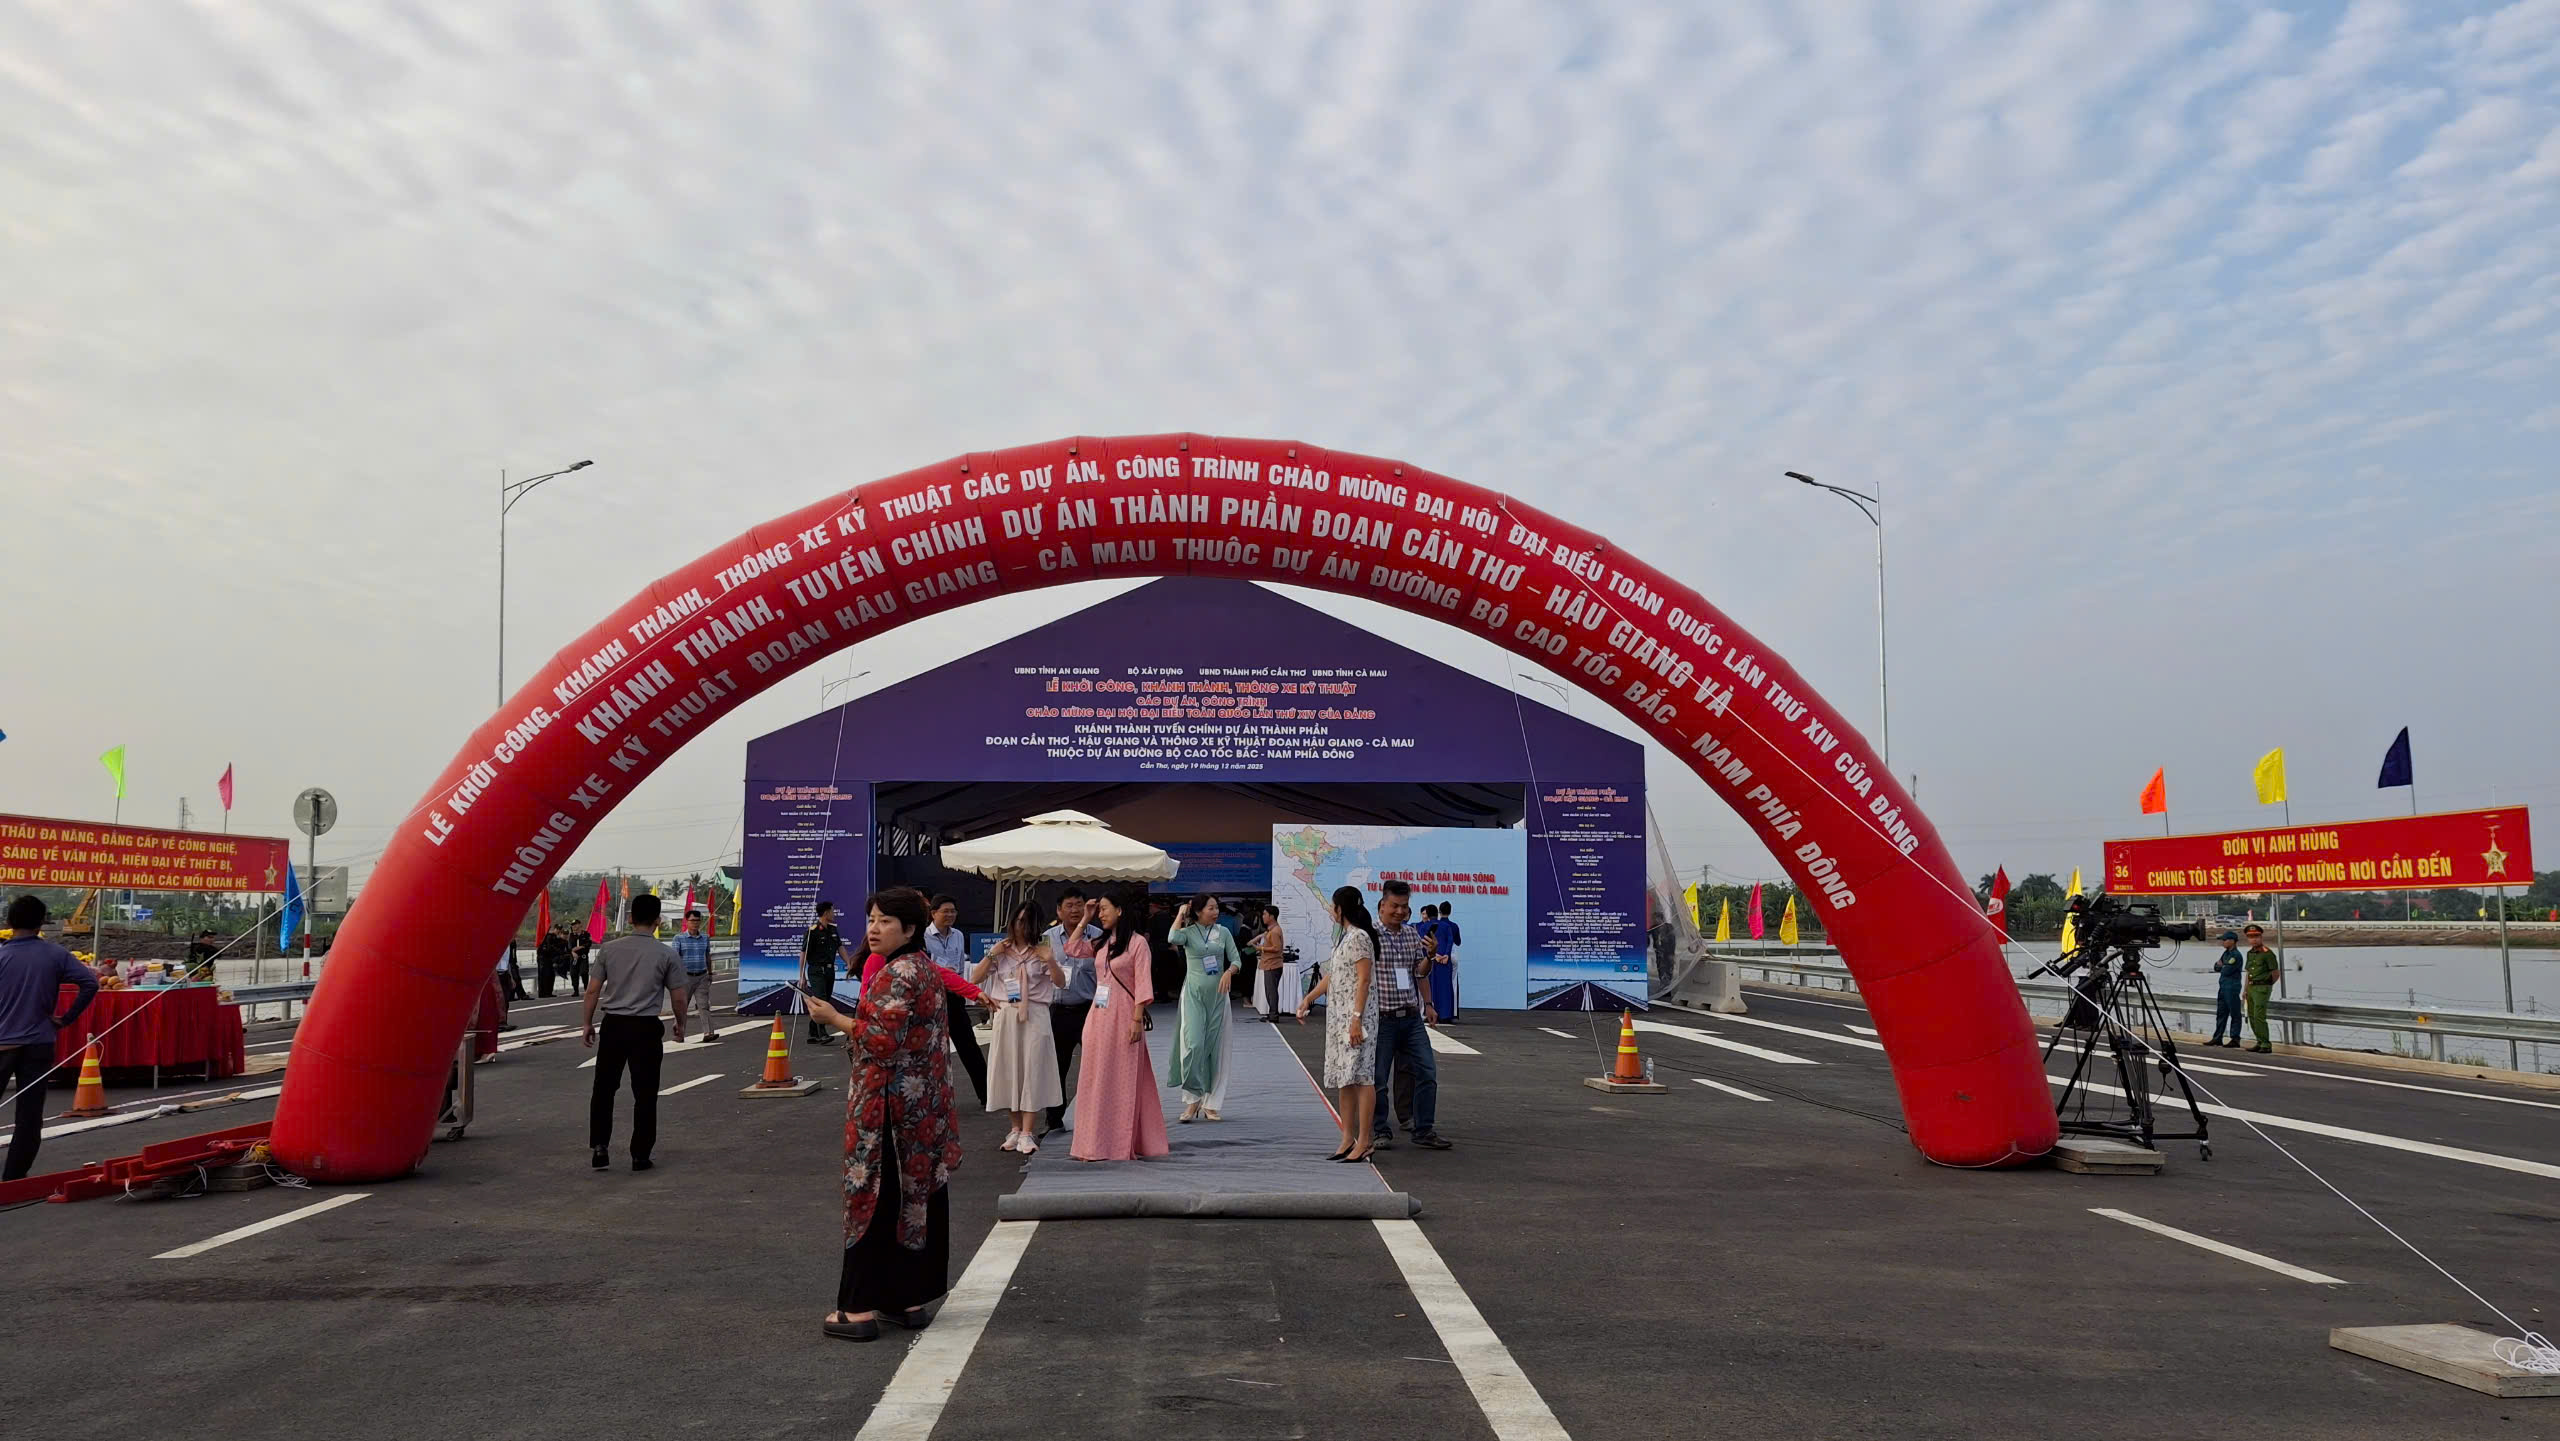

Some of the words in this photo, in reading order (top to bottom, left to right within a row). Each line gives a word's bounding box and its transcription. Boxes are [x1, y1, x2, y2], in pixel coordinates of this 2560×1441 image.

[576, 660, 675, 744] KHÁNH
[673, 595, 784, 666] THÀNH,
[786, 546, 885, 606] TUYẾN
[892, 517, 986, 565] CHÍNH
[1002, 503, 1042, 540] DỰ
[1058, 497, 1096, 530] ÁN
[1110, 489, 1209, 524] THÀNH
[1221, 491, 1302, 533] PHẦN
[1312, 510, 1393, 549] ĐOẠN
[1402, 529, 1463, 569] CẦN
[1468, 549, 1526, 591] THƠ
[1545, 585, 1607, 630] HẬU
[1608, 618, 1695, 689] GIANG
[1692, 676, 1734, 719] VÀ
[424, 810, 454, 846] LỄ
[448, 758, 498, 816] KHỞI
[494, 705, 561, 768] CÔNG,
[554, 639, 629, 705] KHÁNH
[628, 586, 712, 647] THÀNH,
[714, 542, 792, 592] THÔNG
[798, 524, 831, 552] XE
[837, 506, 866, 536] KỸ
[880, 485, 951, 521] THUẬT
[963, 472, 1010, 500] CÁC
[1020, 465, 1053, 493] DỰ
[1066, 460, 1105, 484] ÁN,
[1116, 455, 1180, 480] CÔNG
[1192, 456, 1259, 482] TRÌNH
[1269, 464, 1329, 491] CHÀO
[1339, 474, 1408, 507] MỪNG
[1415, 492, 1454, 522] ĐẠI
[1460, 506, 1499, 538] HỘI
[1508, 521, 1549, 560] ĐẠI
[1553, 541, 1605, 584] BIỂU
[1608, 571, 1664, 615] TOÀN
[1668, 608, 1723, 654] QUỐC
[1723, 648, 1766, 688] LẦN
[1765, 681, 1807, 721] THỨ
[1802, 718, 1839, 753] XIV
[1835, 753, 1873, 798] CỦA
[1869, 796, 1920, 858] ĐẢNG
[1046, 677, 1059, 692] LỄ
[1061, 679, 1093, 692] KHỞI
[1096, 680, 1138, 693] CÔNG,
[1141, 678, 1184, 693] KHÁNH
[1187, 679, 1232, 695] THÀNH,
[1235, 680, 1279, 693] THÔNG
[1281, 683, 1297, 694] XE
[1300, 681, 1316, 694] KỸ
[1319, 682, 1357, 696] THUẬT
[493, 812, 576, 901] THÔNG
[569, 774, 611, 809] XE
[609, 735, 649, 772] KỸ
[747, 620, 830, 673] ĐOẠN
[906, 561, 997, 603] GIANG
[1039, 542, 1077, 570] CÀ
[1092, 540, 1155, 564] MAU
[1173, 536, 1259, 564] THUỘC
[1273, 547, 1312, 571] DỰ
[1320, 552, 1360, 580] ÁN
[1370, 566, 1460, 609] ĐƯỜNG
[1470, 598, 1508, 629] BỘ
[1515, 620, 1567, 655] CAO
[1573, 647, 1621, 684] TỐC
[1624, 681, 1676, 723] BẮC
[1692, 733, 1752, 786] NAM
[1746, 784, 1802, 840] PHÍA
[1791, 842, 1856, 910] ĐÔNG
[1075, 723, 1112, 734] KHÁNH
[1115, 723, 1151, 734] THÀNH
[1153, 722, 1185, 734] TUYẾN
[1188, 722, 1222, 734] CHÍNH
[1225, 725, 1241, 737] DỰ
[1243, 725, 1258, 735] ÁN
[1261, 725, 1296, 735] THÀNH
[1299, 723, 1328, 736] PHẦN
[986, 736, 1017, 748] ĐOẠN
[1021, 732, 1045, 746] CẦN
[1048, 735, 1070, 746] THƠ
[1078, 736, 1101, 748] HẬU
[1104, 737, 1140, 746] GIANG
[1143, 736, 1158, 746] VÀ
[1161, 735, 1198, 746] THÔNG
[1202, 737, 1214, 747] XE
[1217, 737, 1231, 747] KỸ
[1234, 737, 1266, 749] THUẬT
[1269, 738, 1300, 749] ĐOẠN
[1303, 738, 1326, 750] HẬU
[1328, 738, 1363, 747] GIANG
[1372, 737, 1388, 748] CÀ
[1391, 739, 1414, 748] MAU
[1047, 748, 1084, 759] THUỘC
[1087, 748, 1103, 759] DỰ
[1105, 747, 1120, 758] ÁN
[1123, 747, 1163, 758] ĐƯỜNG
[1166, 748, 1181, 759] BỘ
[1184, 748, 1208, 758] CAO
[1211, 747, 1234, 759] TỐC
[1236, 747, 1259, 759] BẮC
[1267, 749, 1292, 759] NAM
[1295, 749, 1320, 759] PHÍA
[1323, 749, 1354, 759] ĐÔNG
[2223, 837, 2249, 856] ĐƠN
[2252, 837, 2266, 857] VỊ
[2269, 835, 2296, 852] ANH
[2300, 829, 2339, 851] HÙNG
[2115, 866, 2129, 878] 36
[2148, 868, 2186, 887] CHÚNG
[2188, 866, 2207, 886] TÔI
[2211, 866, 2225, 884] SẼ
[2229, 862, 2253, 884] ĐẾN
[2257, 863, 2293, 886] ĐƯỢC
[2297, 860, 2346, 882] NHỮNG
[2350, 859, 2376, 880] NƠI
[2381, 852, 2413, 879] CẦN
[2418, 850, 2452, 877] ĐẾN
